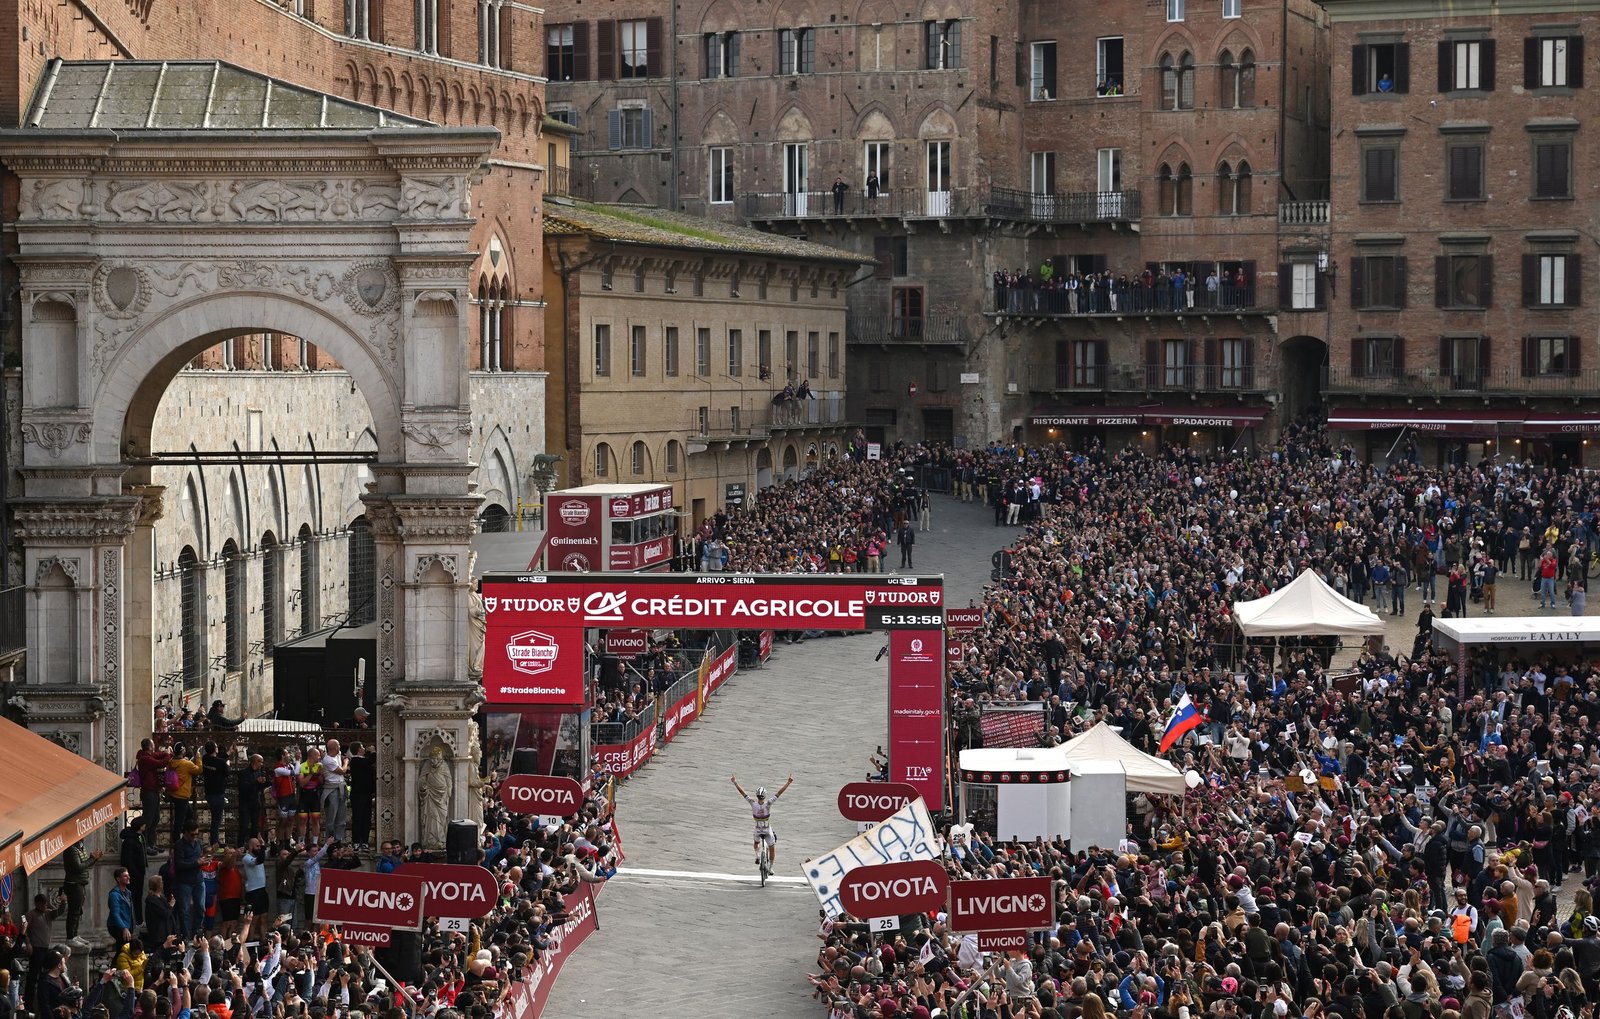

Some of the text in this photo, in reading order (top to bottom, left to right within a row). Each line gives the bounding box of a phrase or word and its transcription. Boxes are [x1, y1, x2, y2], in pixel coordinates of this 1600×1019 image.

[1173, 418, 1232, 427] SPADAFORTE
[550, 536, 592, 546] Continental
[878, 591, 928, 603] TUDOR
[501, 598, 566, 612] TUDOR
[631, 594, 727, 616] CRÉDIT
[731, 599, 864, 617] AGRICOLE
[881, 615, 942, 625] 5:13:58
[948, 614, 981, 622] LIVIGNO
[1530, 631, 1582, 641] EATALY
[609, 638, 644, 647] LIVIGNO
[512, 647, 553, 657] Strade Bianche
[500, 686, 566, 694] #StradeBianche
[906, 766, 928, 777] ITA
[508, 786, 575, 804] TOYOTA
[846, 794, 910, 810] TOYOTA
[547, 816, 557, 824] 10
[425, 881, 486, 902] YOTA
[849, 876, 938, 902] TOYOTA
[324, 886, 414, 911] LIVIGNO
[957, 893, 1046, 915] LIVIGNO
[447, 920, 460, 929] 25
[879, 919, 893, 929] 25
[343, 930, 389, 943] LIVIGNO
[980, 936, 1025, 947] LIVIGNO
